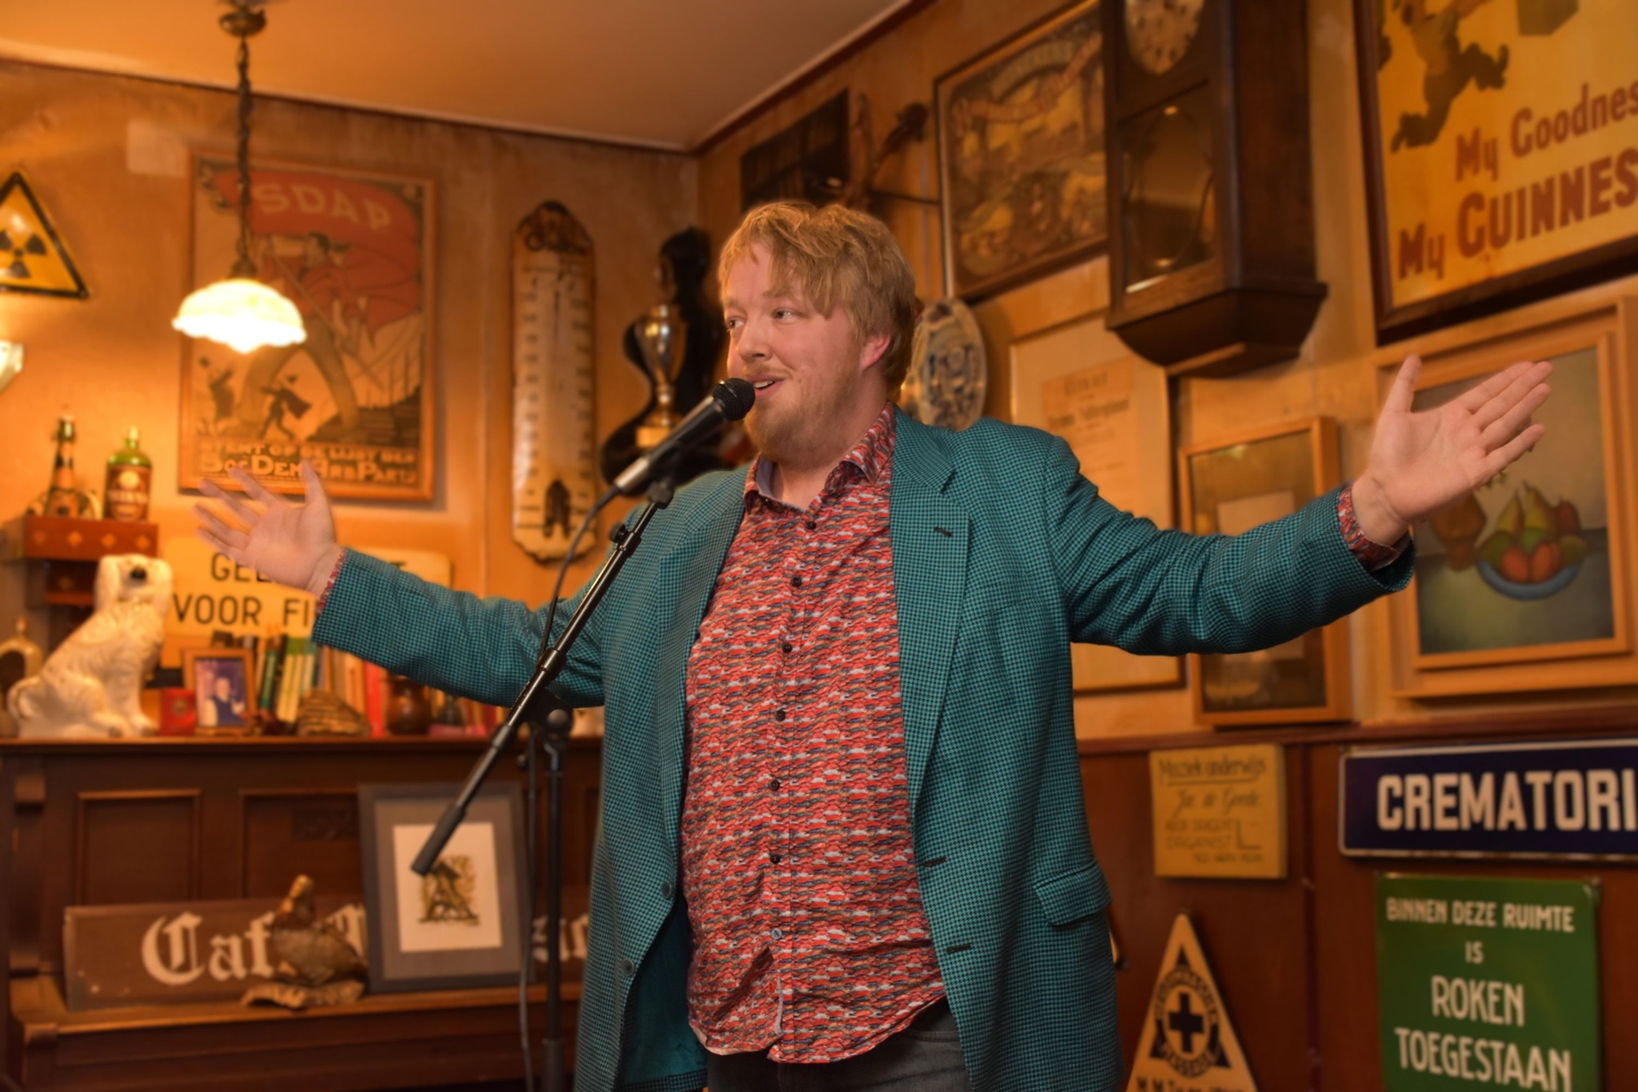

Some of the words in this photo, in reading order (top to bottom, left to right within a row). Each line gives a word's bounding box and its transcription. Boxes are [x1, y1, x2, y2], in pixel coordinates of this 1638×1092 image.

[1456, 127, 1498, 183] My
[251, 182, 391, 232] SDAP
[1399, 222, 1446, 281] My
[172, 593, 261, 626] VOOR
[283, 597, 310, 628] FI
[1377, 769, 1638, 832] CREMATORI
[1386, 896, 1448, 924] BINNEN
[1452, 900, 1497, 927] DEZE
[1503, 903, 1575, 933] RUIMTE
[141, 911, 297, 985] Caf
[1465, 941, 1484, 964] IS
[1431, 975, 1525, 1027] ROKEN
[1394, 1027, 1572, 1092] TOEGESTAAN
